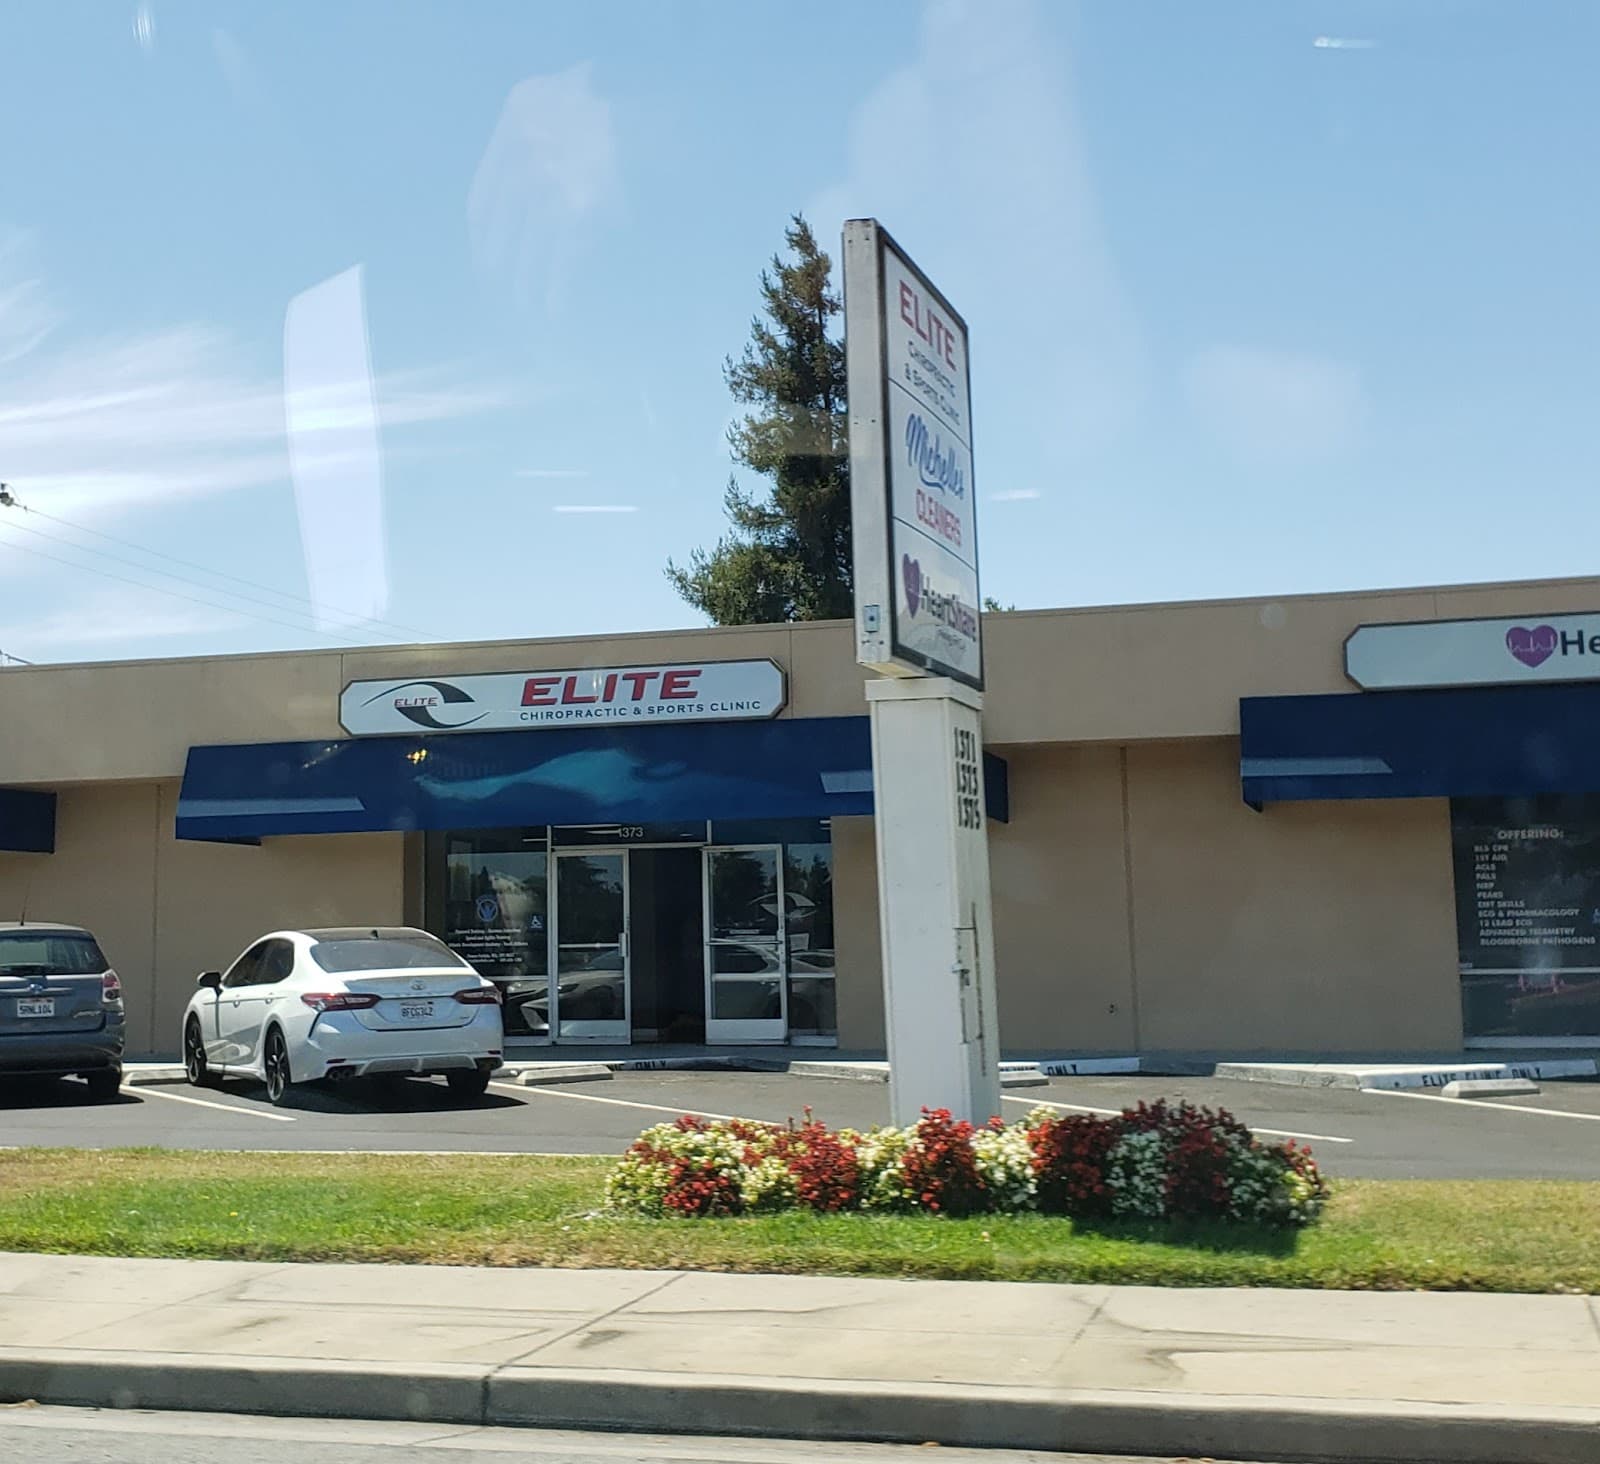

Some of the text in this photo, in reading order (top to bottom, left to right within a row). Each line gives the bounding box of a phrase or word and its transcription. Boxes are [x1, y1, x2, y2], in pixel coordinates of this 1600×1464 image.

[899, 279, 957, 372] ELITE
[915, 487, 962, 547] CLEANERS
[394, 696, 438, 707] ELITE
[520, 669, 703, 706] ELITE
[519, 700, 761, 721] CHIROPRACTIC & SPORTS CLINIC
[954, 726, 976, 763] 1371
[956, 760, 978, 796] 1373
[618, 826, 644, 838] 1373
[1497, 828, 1565, 840] OFFERING:
[1047, 1063, 1078, 1077] ONLY
